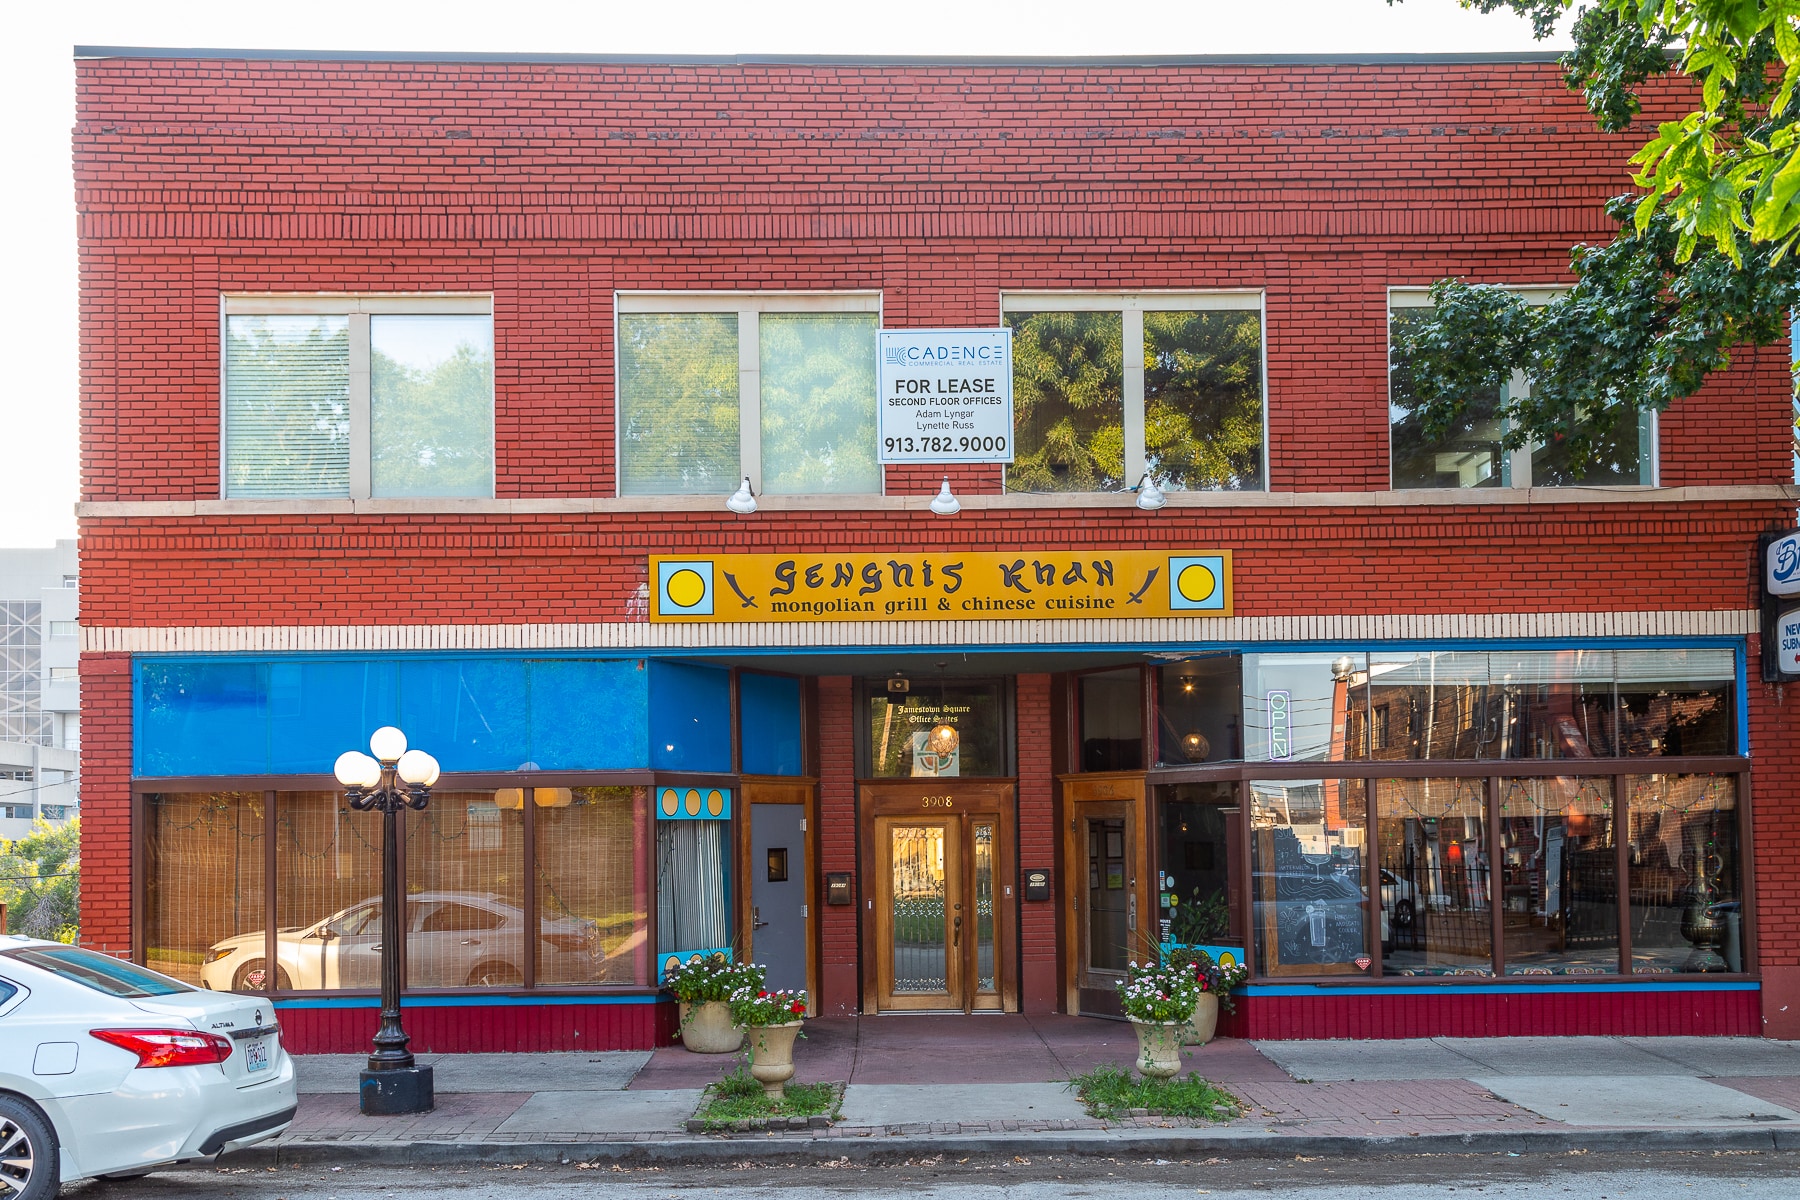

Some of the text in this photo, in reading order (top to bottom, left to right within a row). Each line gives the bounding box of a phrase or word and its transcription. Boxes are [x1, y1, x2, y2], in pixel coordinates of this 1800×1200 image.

[907, 345, 1003, 360] CADENCE
[895, 378, 995, 394] FOR LEASE
[888, 396, 1002, 406] SECOND FLOOR OFFICES
[915, 409, 975, 420] Adam Lyngar
[916, 421, 975, 432] Lynette Russ
[884, 436, 1006, 453] 913.782.9000
[771, 594, 1115, 615] mongolian grill & chinese cuisine
[897, 705, 971, 715] Jamestown Square
[908, 715, 931, 723] Office
[1270, 694, 1288, 757] OPEN
[921, 796, 953, 808] 3908
[211, 1021, 234, 1029] ALTIMA
